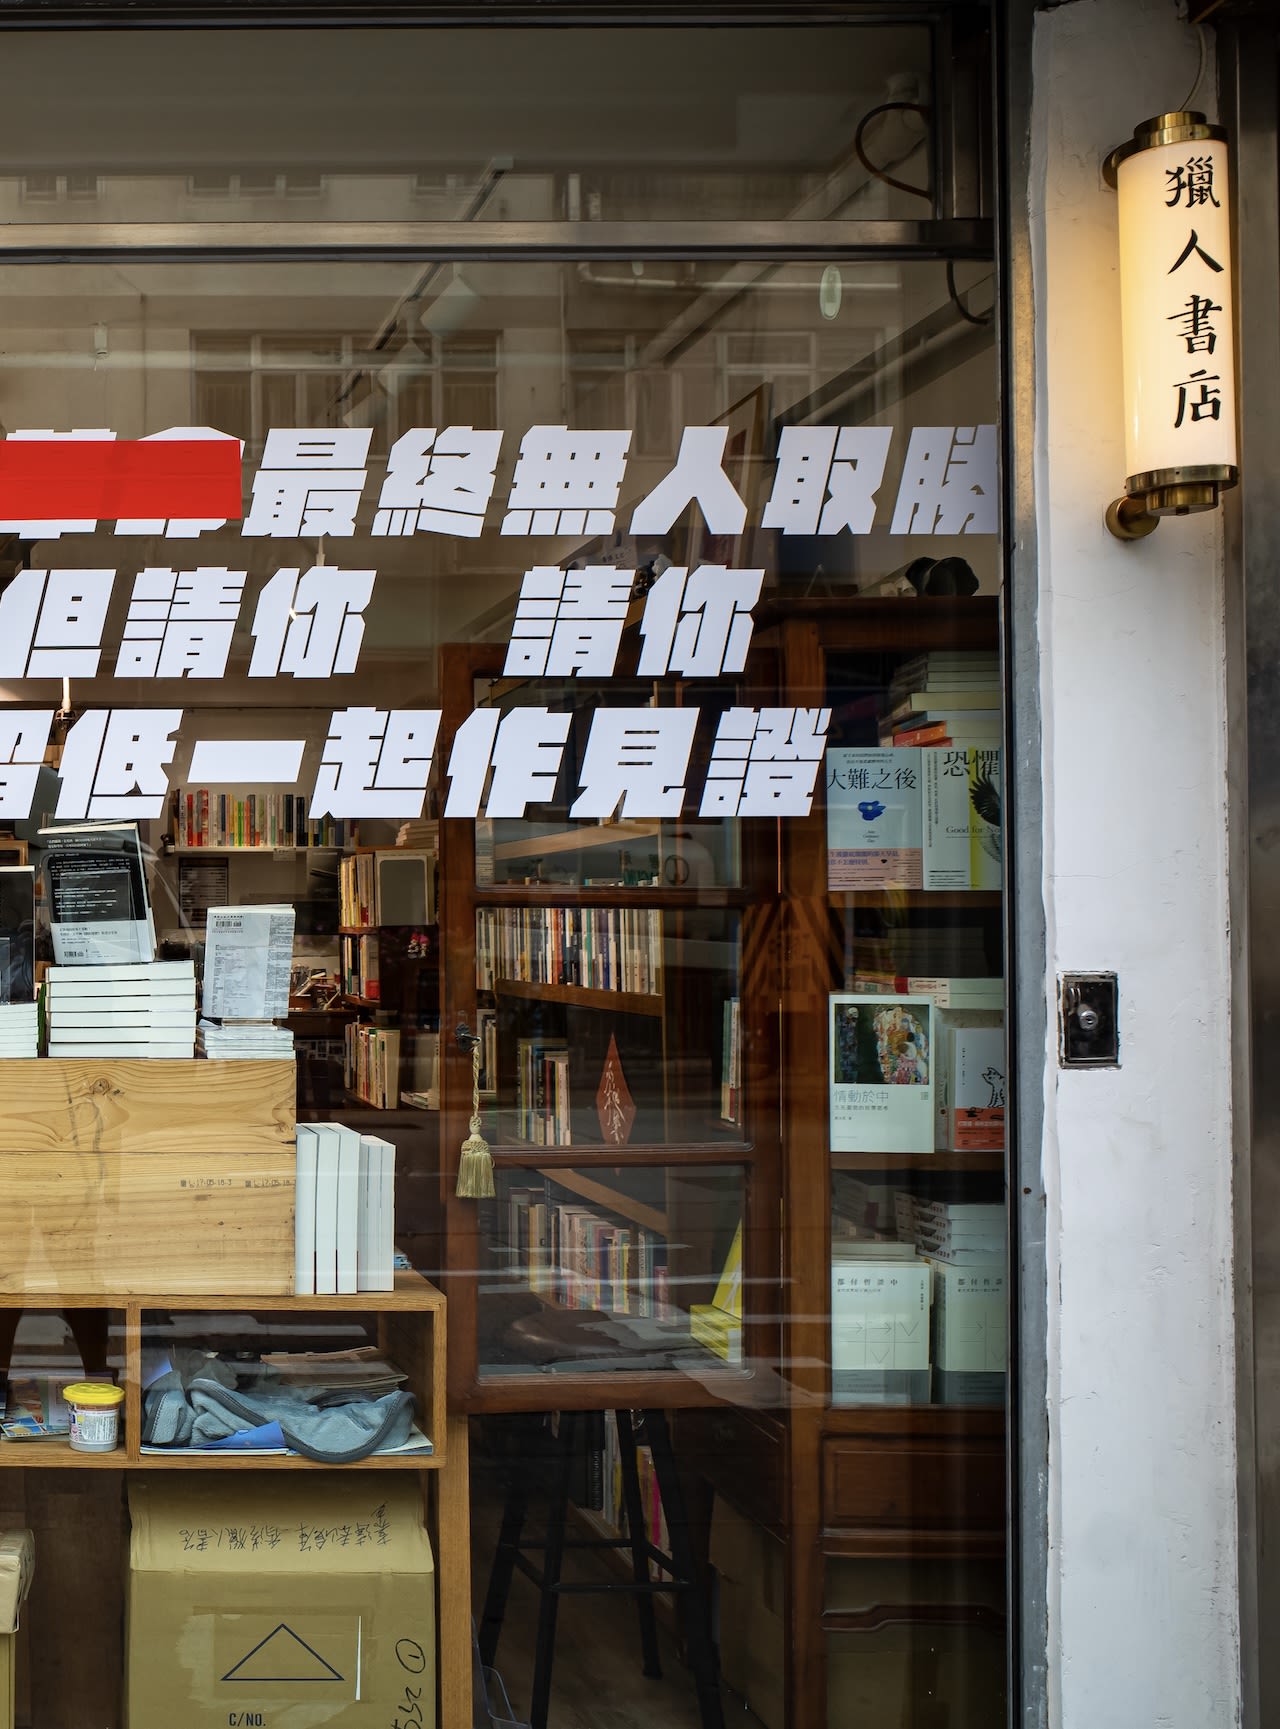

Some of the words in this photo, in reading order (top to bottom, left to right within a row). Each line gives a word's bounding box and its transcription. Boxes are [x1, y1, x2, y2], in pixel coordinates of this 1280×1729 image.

[1166, 157, 1224, 428] 獵人書店
[502, 565, 765, 677] 請你
[943, 750, 1000, 777] 恐懼
[826, 768, 917, 790] 大難之後
[946, 825, 969, 834] Good
[228, 1712, 266, 1727] C/NO.
